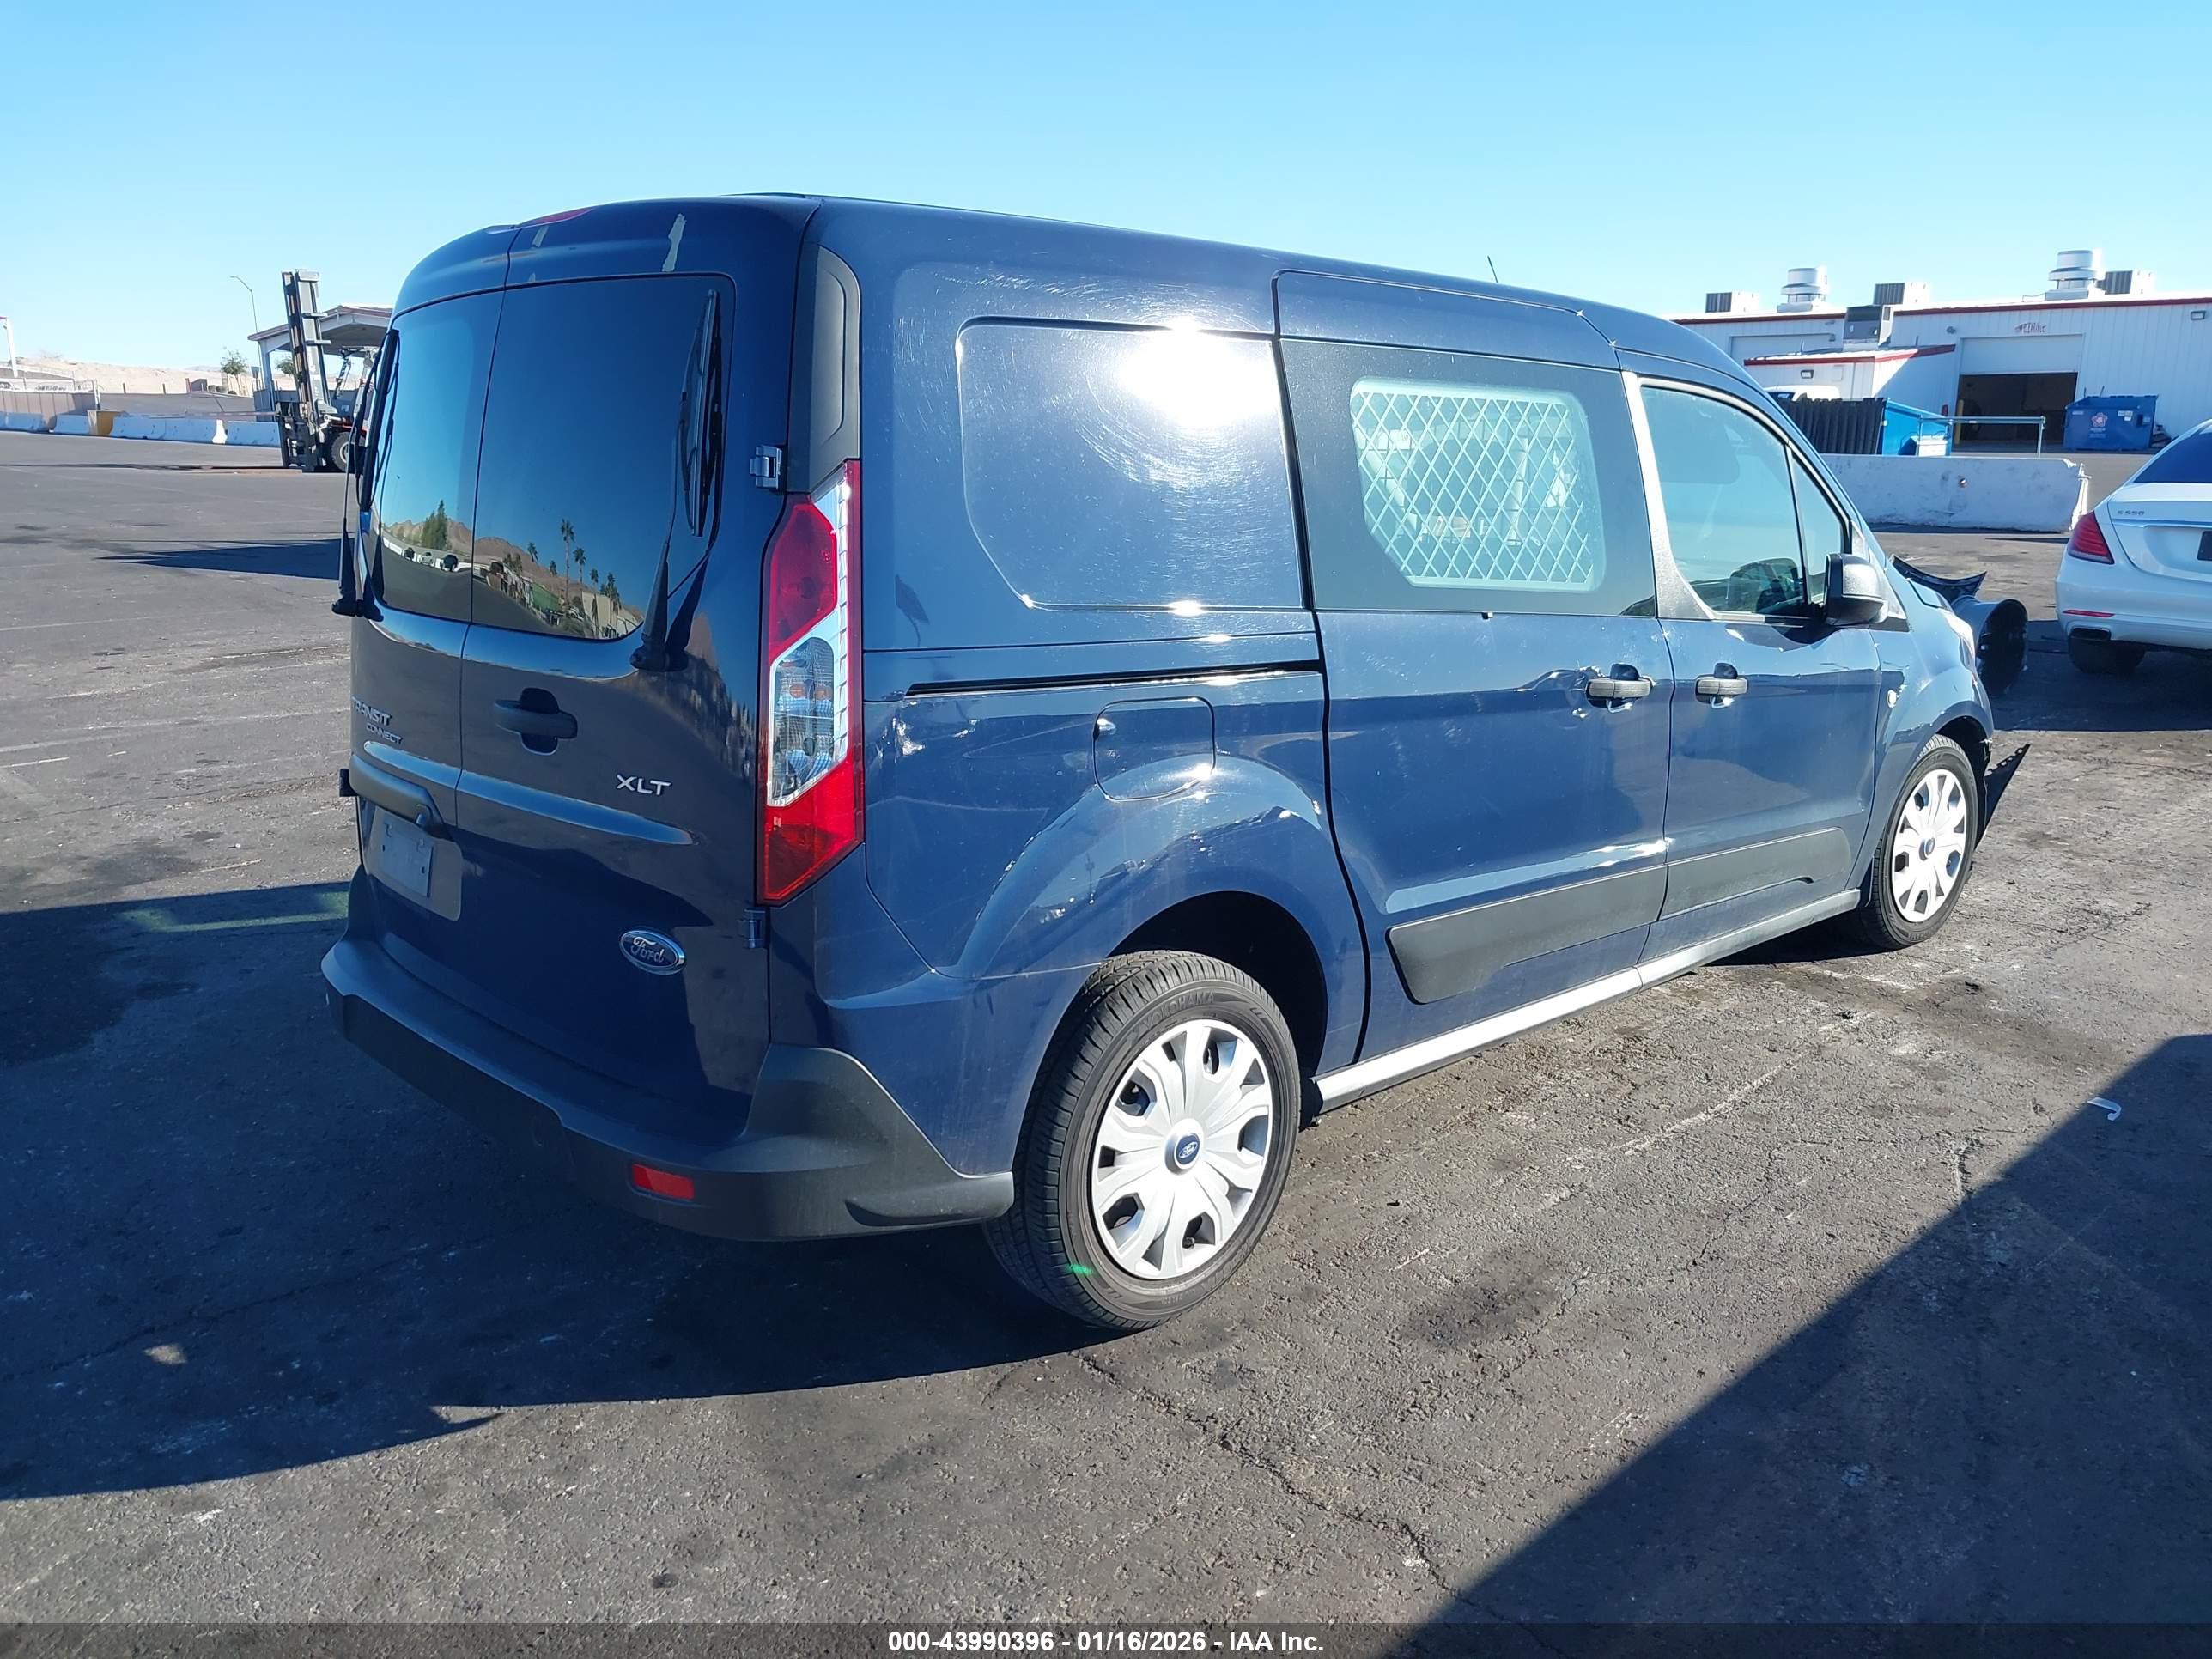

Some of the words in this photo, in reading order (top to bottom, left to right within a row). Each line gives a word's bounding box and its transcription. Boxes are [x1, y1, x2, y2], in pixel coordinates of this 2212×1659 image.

[351, 696, 392, 726] TRANSIT
[366, 722, 403, 745] CONNECT
[616, 774, 672, 796] XLT
[629, 936, 665, 963] Ford
